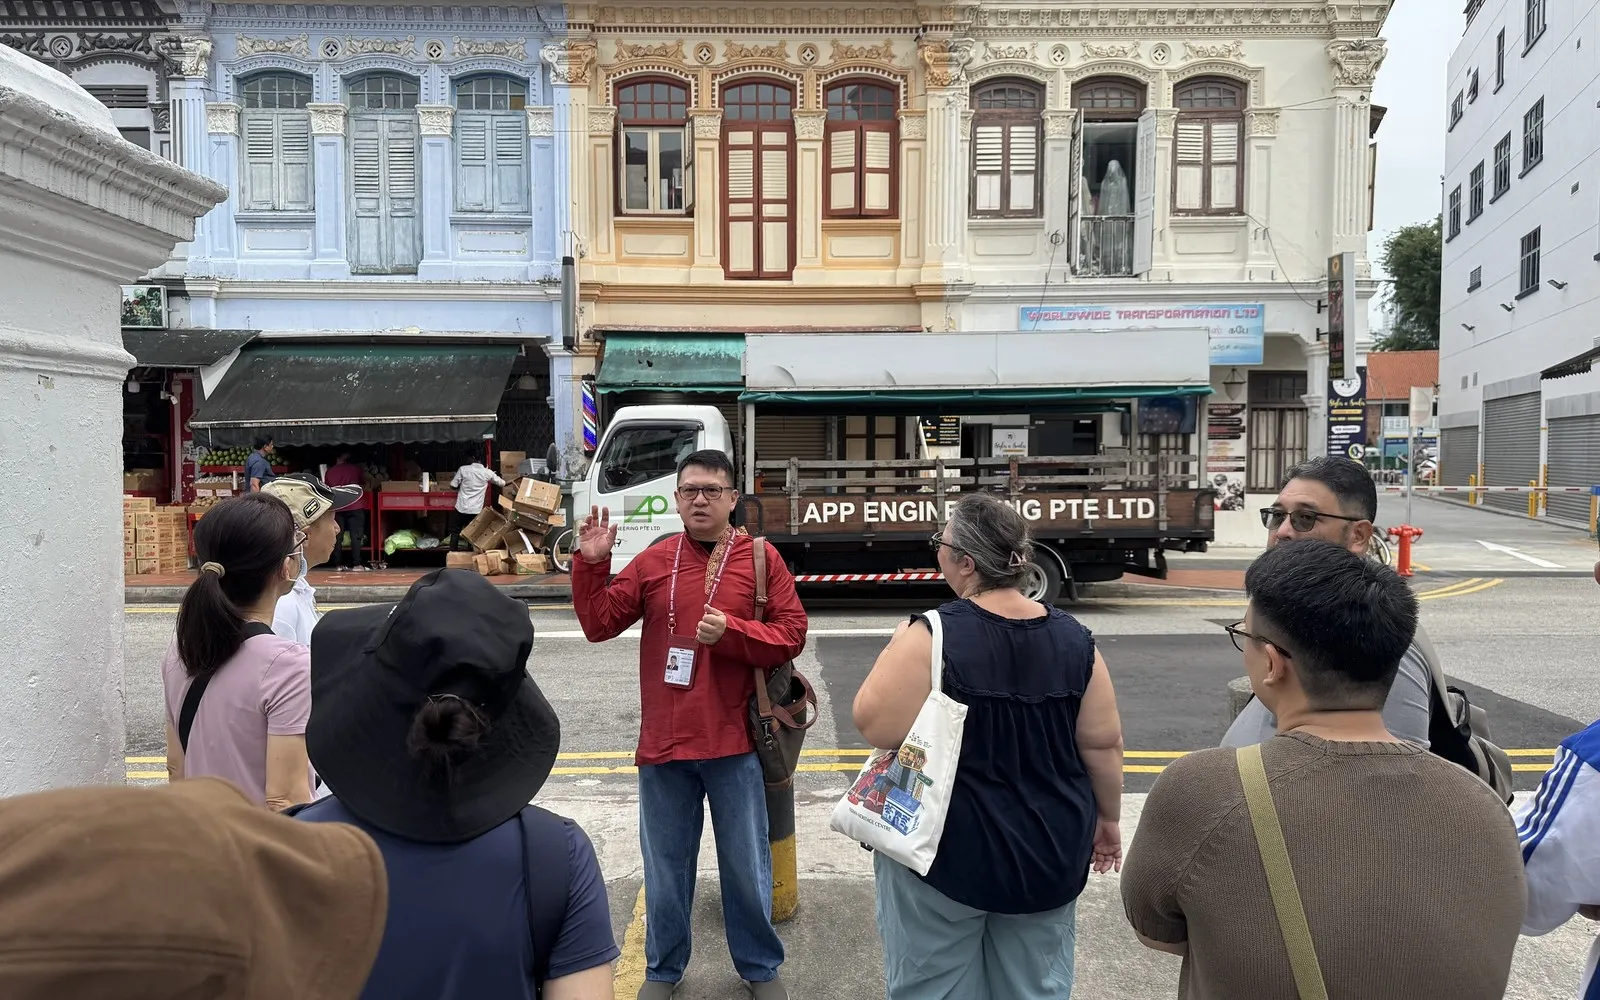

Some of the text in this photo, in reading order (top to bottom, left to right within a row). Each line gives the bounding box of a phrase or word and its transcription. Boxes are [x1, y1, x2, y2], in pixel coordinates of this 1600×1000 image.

[1027, 310, 1111, 321] WORLDWIDE
[1235, 307, 1259, 319] LTD
[803, 502, 855, 523] APP
[1050, 498, 1100, 520] PTE
[1107, 497, 1155, 519] LTD
